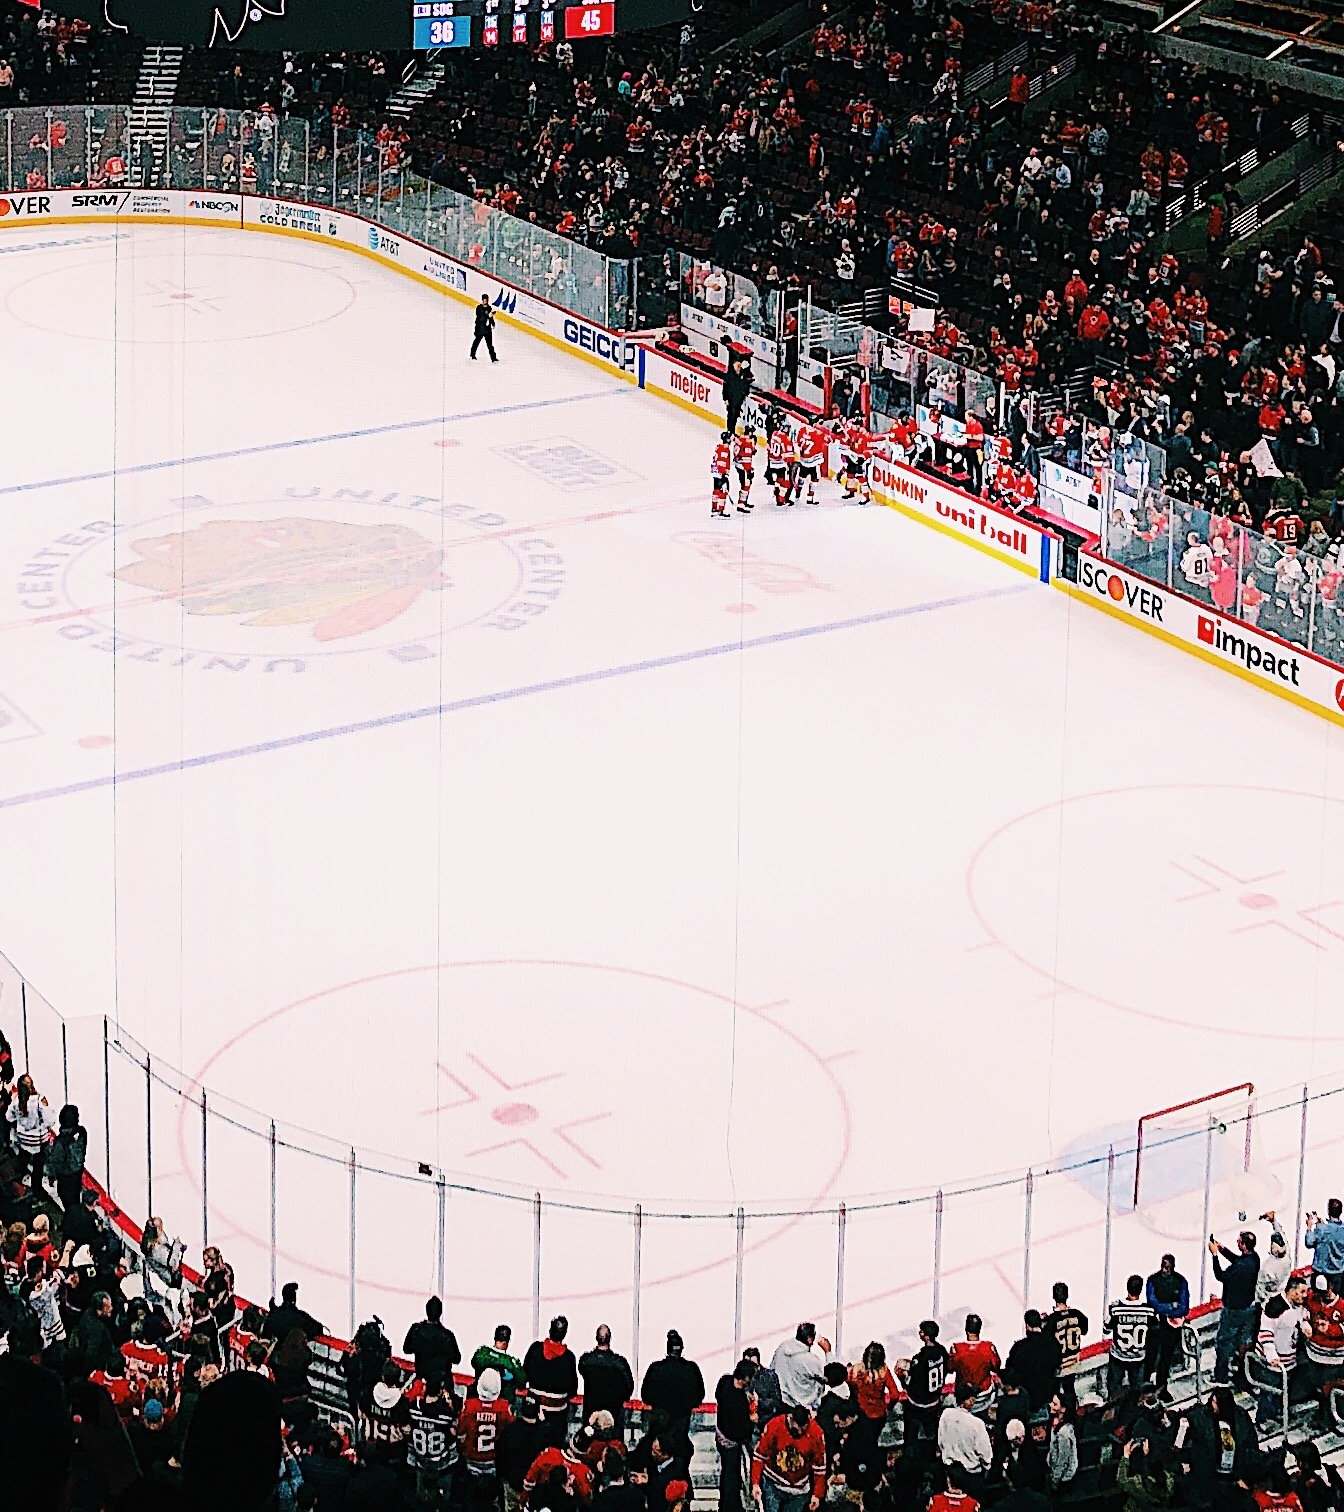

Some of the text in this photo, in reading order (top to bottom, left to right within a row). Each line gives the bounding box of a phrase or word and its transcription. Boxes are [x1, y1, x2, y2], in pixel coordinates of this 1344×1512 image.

[432, 2, 454, 16] SOG
[581, 11, 600, 31] 45
[431, 21, 454, 44] 36
[72, 195, 118, 207] SRM
[260, 214, 287, 226] COLD
[380, 237, 400, 256] AT&T
[564, 319, 636, 365] GEICO
[670, 370, 710, 404] meijer
[873, 466, 927, 504] DUNKIN'
[282, 485, 508, 529] UNITED
[1282, 524, 1296, 540] 19
[17, 518, 122, 611] CENTER
[1194, 557, 1209, 574] 81
[494, 536, 567, 633] CENTER
[1078, 563, 1164, 622] ISCOVER
[1216, 620, 1299, 686] impact
[1117, 1325, 1147, 1352] 50
[412, 1430, 444, 1454] 88
[478, 1425, 495, 1450] 2
